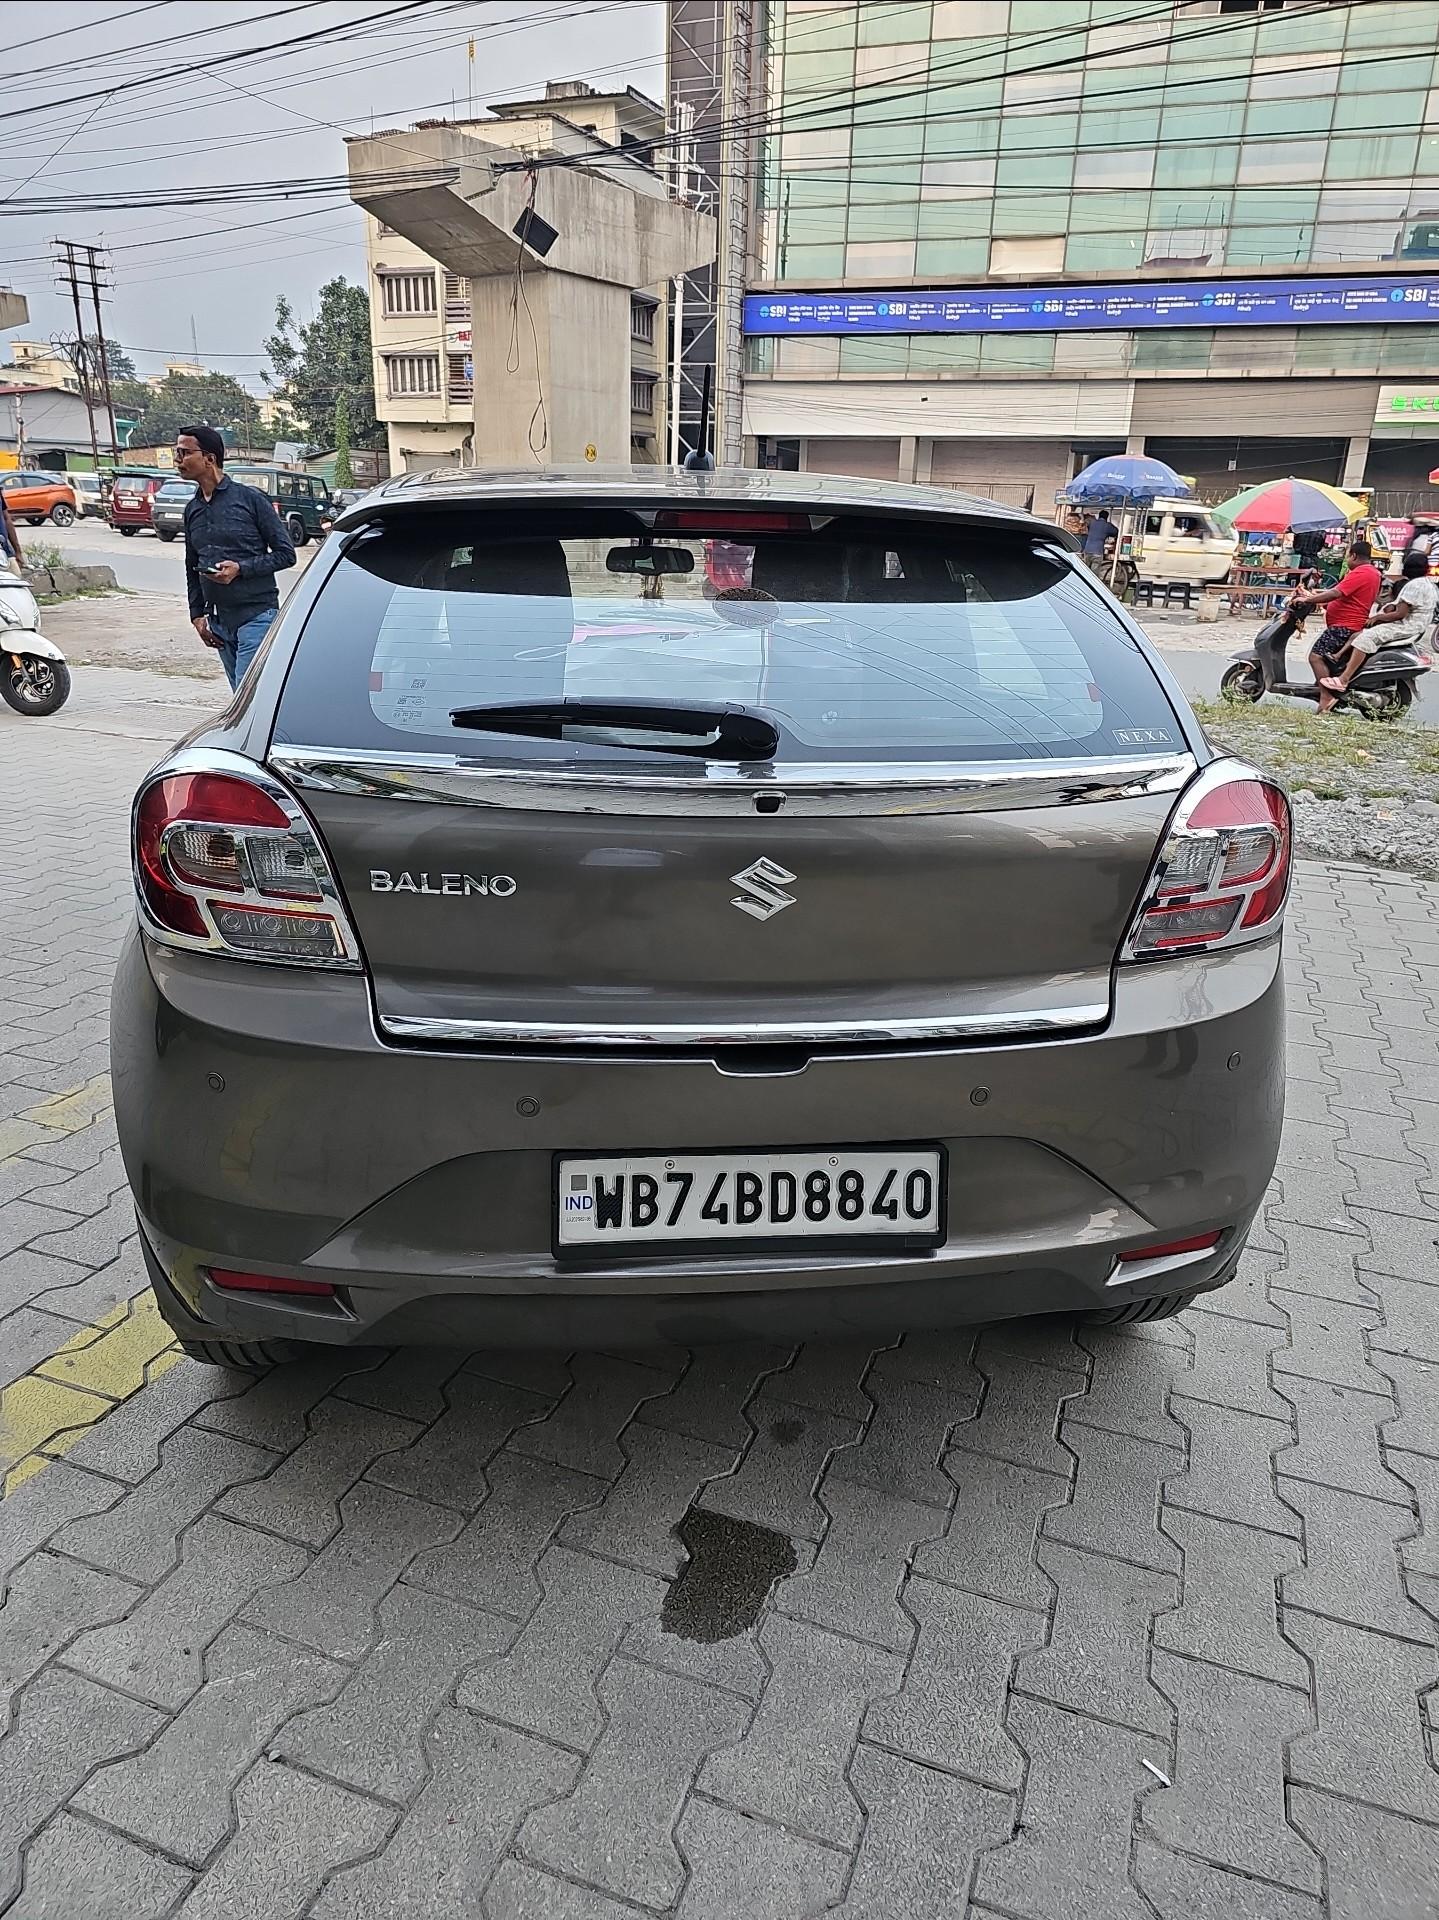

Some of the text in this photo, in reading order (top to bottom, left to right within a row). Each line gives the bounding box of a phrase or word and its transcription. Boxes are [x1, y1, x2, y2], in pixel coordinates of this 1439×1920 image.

[1214, 292, 1237, 306] SBI
[1404, 289, 1428, 302] SBI
[769, 305, 787, 318] SBI
[888, 303, 907, 316] SBI
[1043, 299, 1064, 313] SBI
[1118, 730, 1170, 743] NEXA
[369, 869, 517, 897] BALENO
[565, 1195, 593, 1211] IND
[594, 1168, 932, 1229] WB74BD8840
